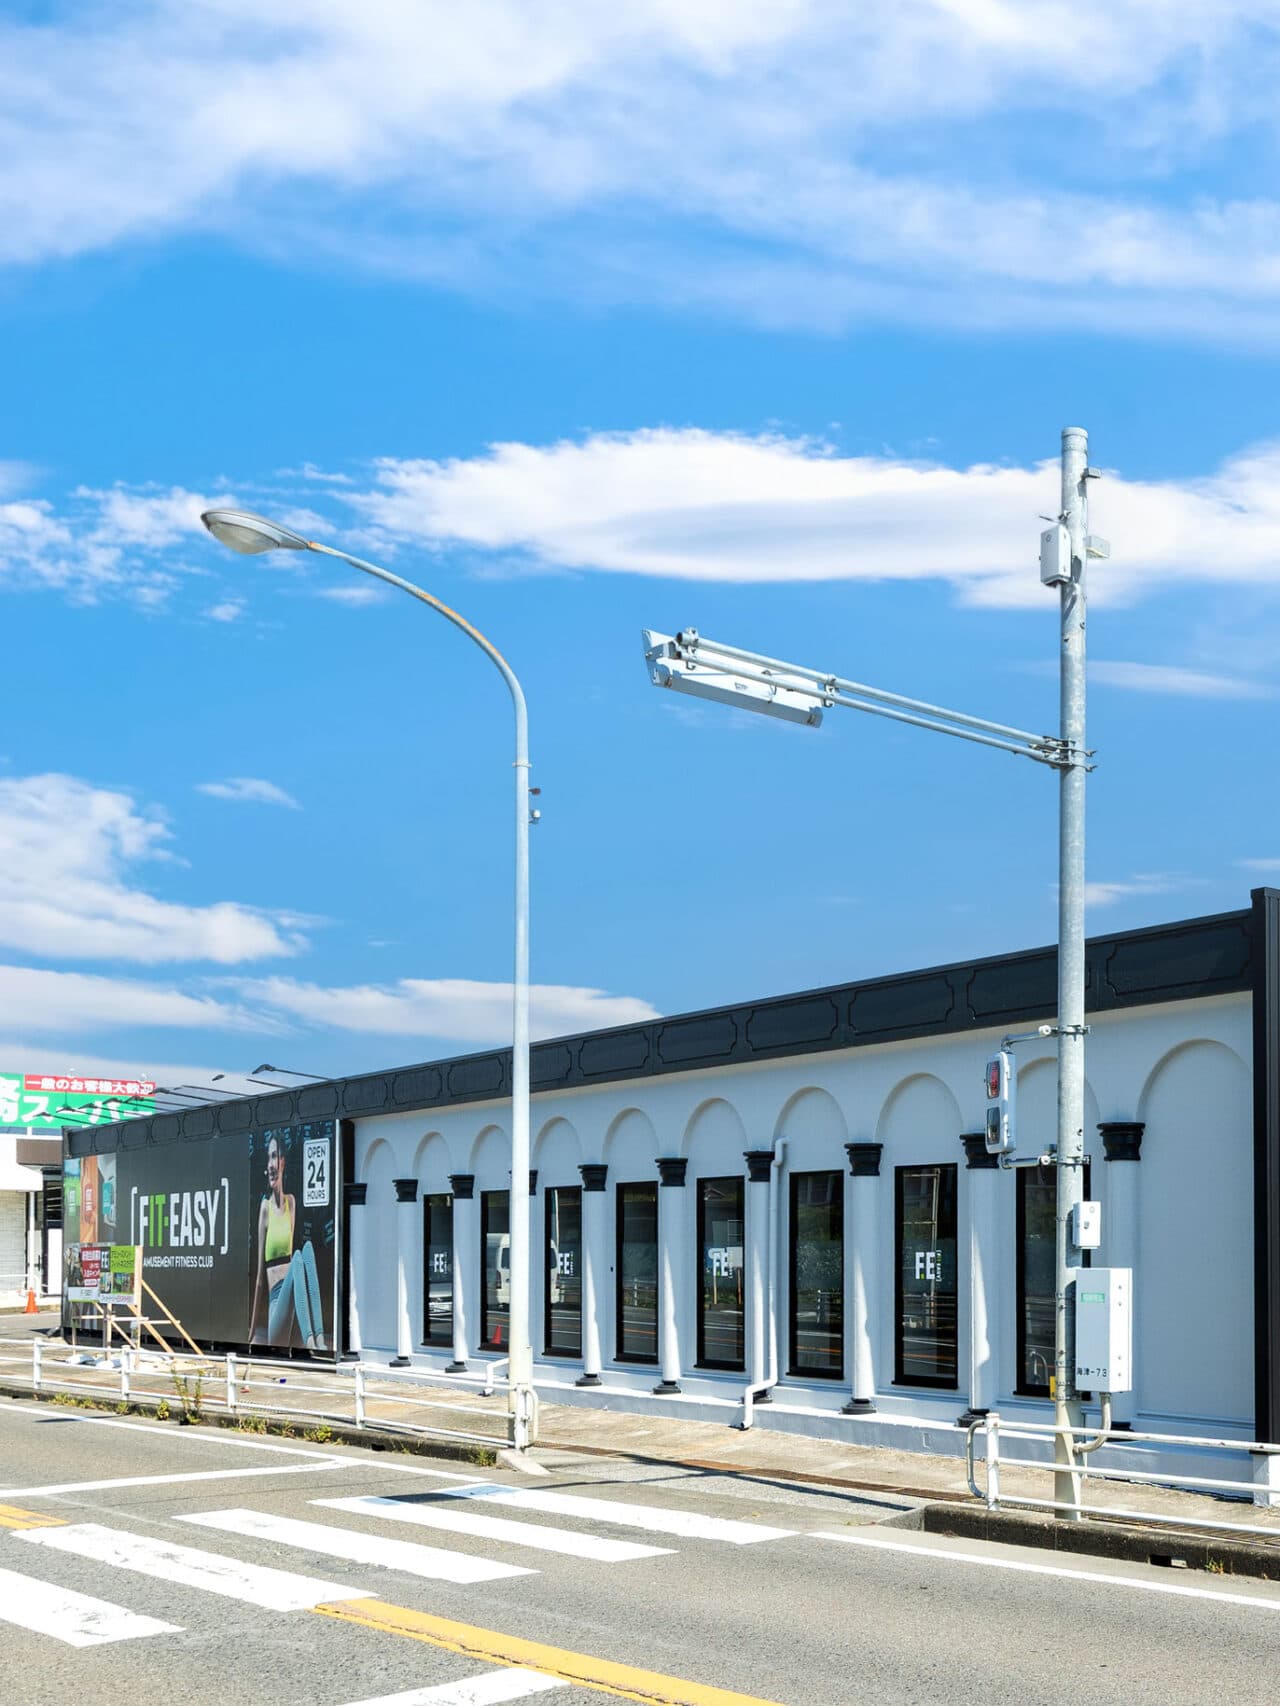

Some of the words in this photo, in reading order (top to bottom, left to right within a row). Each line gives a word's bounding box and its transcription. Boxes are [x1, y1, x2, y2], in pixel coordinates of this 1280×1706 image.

[307, 1146, 326, 1159] OPEN
[307, 1160, 326, 1189] 24
[307, 1189, 326, 1200] HOURS
[144, 1256, 175, 1268] AMUSEMENT
[175, 1256, 198, 1268] FITNESS
[198, 1255, 214, 1268] CLUB
